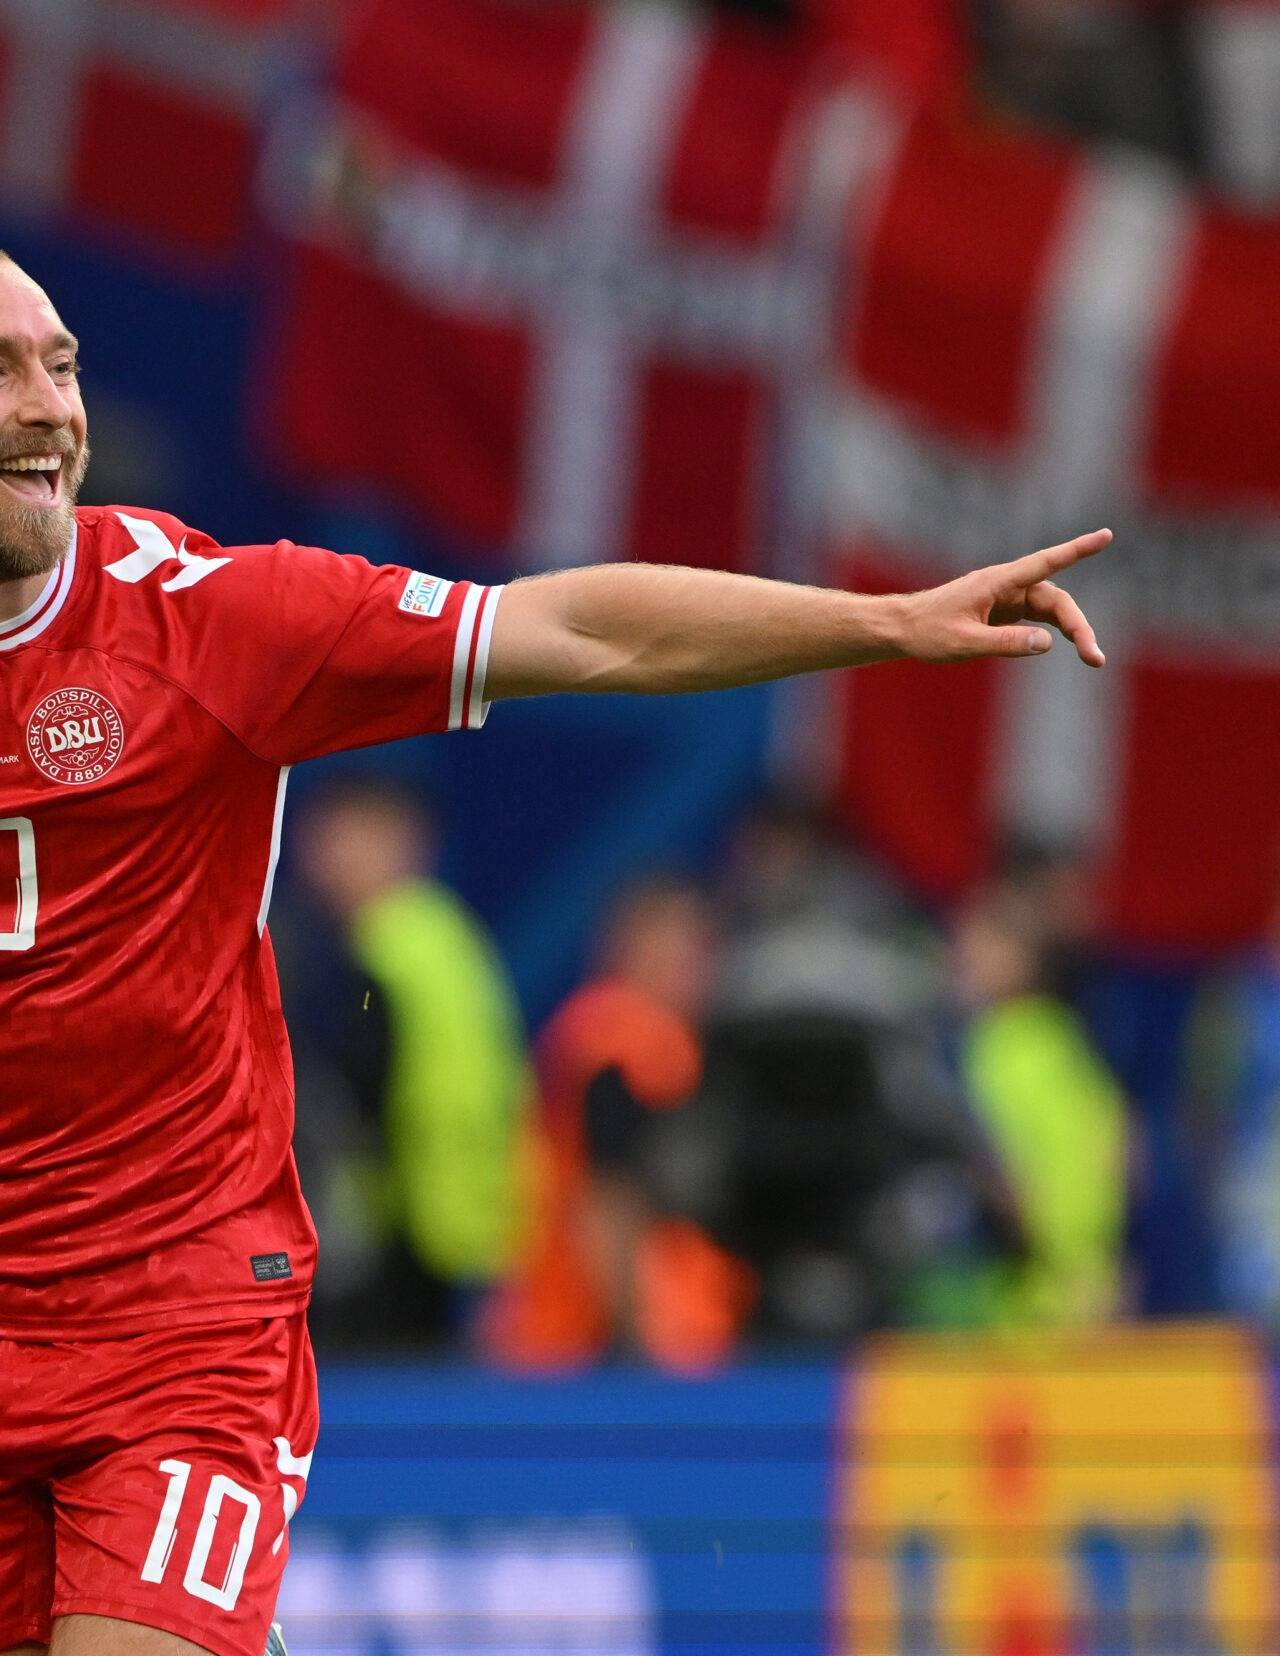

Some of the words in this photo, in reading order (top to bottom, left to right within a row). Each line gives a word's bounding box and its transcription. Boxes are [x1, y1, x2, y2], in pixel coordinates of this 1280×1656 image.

[402, 589, 416, 609] UEFA
[30, 724, 61, 776] DANSK
[45, 716, 105, 753] DBU
[66, 764, 103, 781] 1889
[140, 1458, 261, 1612] 10
